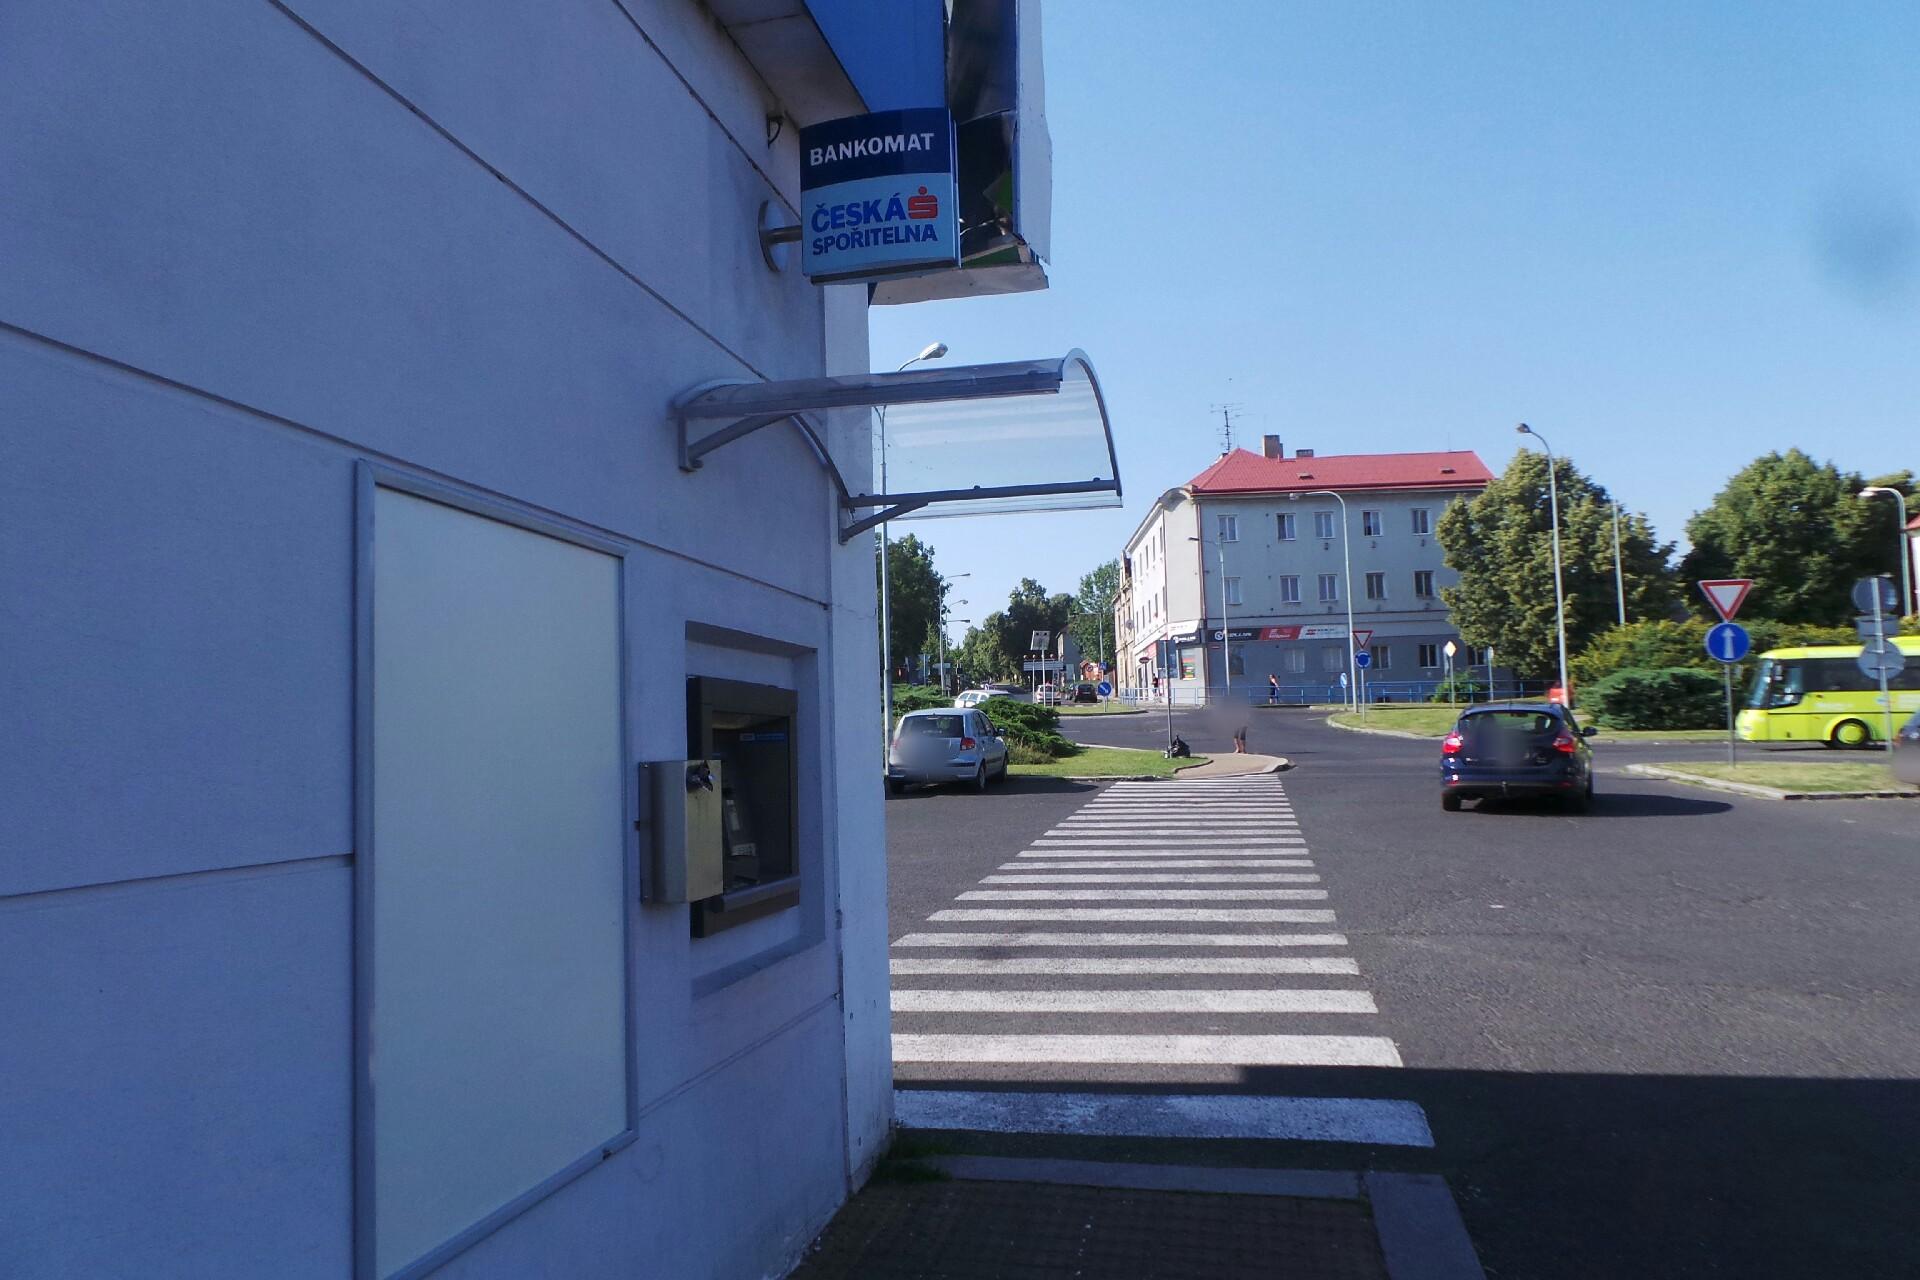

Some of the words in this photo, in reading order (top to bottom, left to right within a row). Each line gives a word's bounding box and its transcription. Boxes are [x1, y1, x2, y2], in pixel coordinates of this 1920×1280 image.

[810, 133, 934, 166] BANKOMAT
[811, 193, 906, 232] ČESKÁ
[813, 224, 938, 255] SPOŘITELNA
